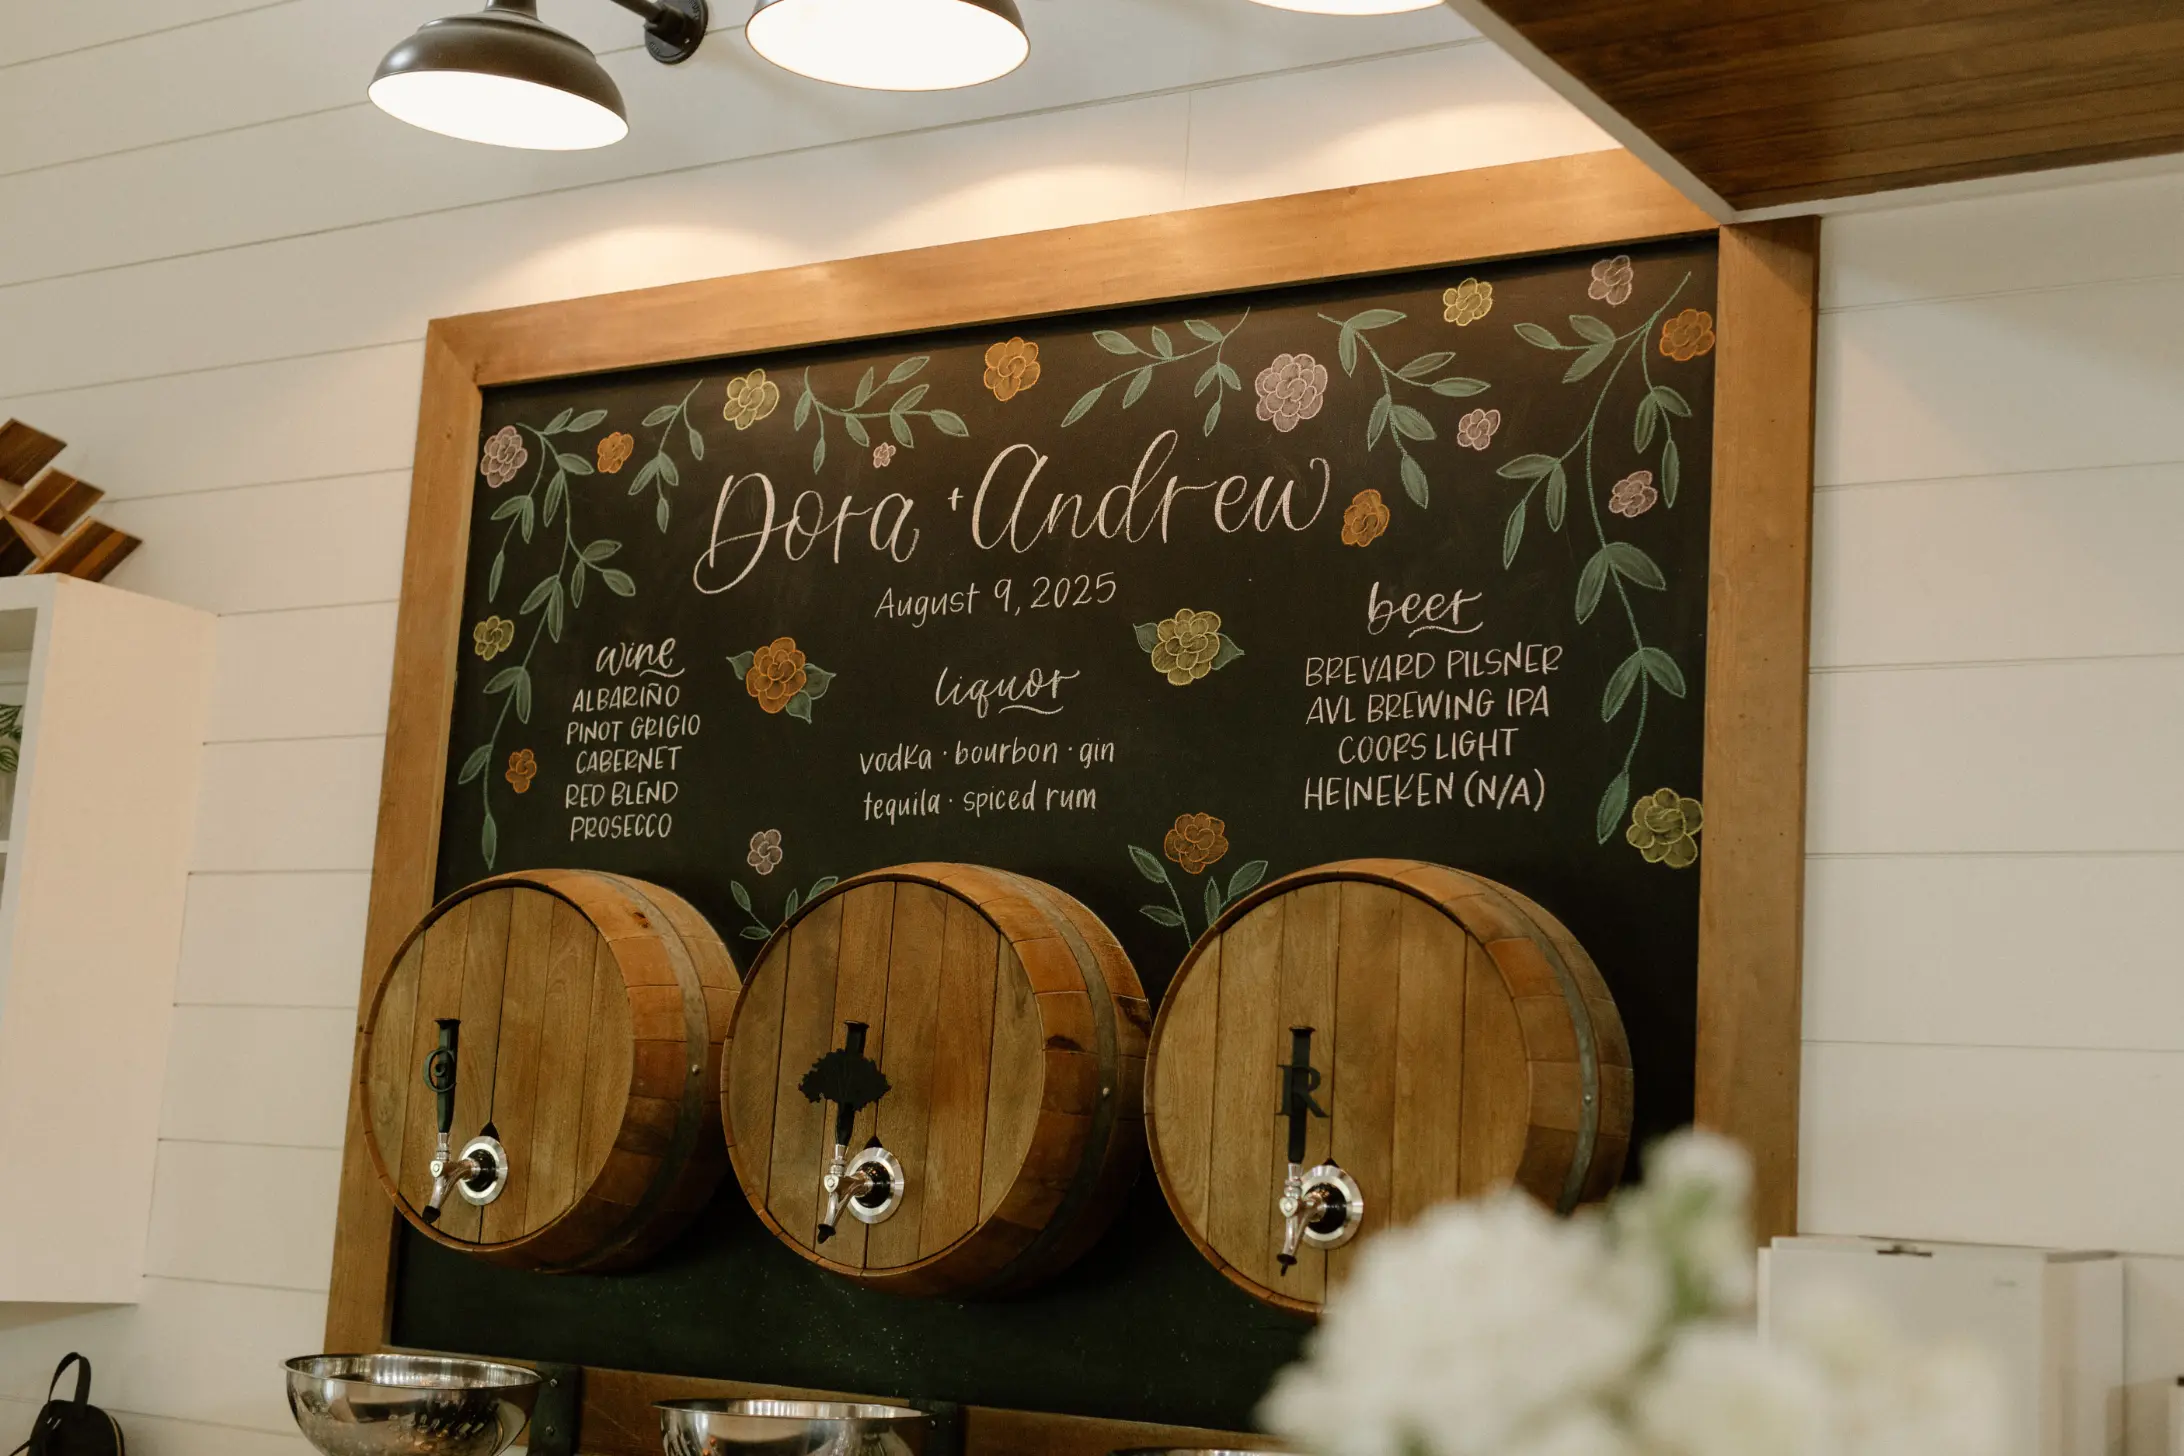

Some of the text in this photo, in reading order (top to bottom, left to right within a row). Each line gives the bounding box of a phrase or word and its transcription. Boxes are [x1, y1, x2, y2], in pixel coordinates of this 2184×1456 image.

[692, 471, 921, 595] Dora
[971, 429, 1331, 554] Andrew
[874, 571, 1117, 629] August 9, 2025
[1367, 581, 1484, 636] beer
[595, 637, 677, 677] wine
[1305, 641, 1563, 687] BREVARD PILSNER
[571, 682, 680, 713] ALBARIÑO
[935, 666, 1081, 719] liquor
[1305, 685, 1550, 725] AVL BREWING IPA
[566, 714, 701, 746] PINOT GRIGIO
[1338, 727, 1519, 765] COORS LIGHT
[576, 745, 683, 774] CABERNET
[955, 736, 1058, 765] bourbon
[1078, 737, 1116, 769] gin
[565, 780, 679, 809] RED BLEND
[863, 781, 1097, 825] tequila spiced rum
[1304, 768, 1545, 812] HEINEKEN (N/A)
[570, 813, 672, 842] PROSECCO
[1275, 1063, 1330, 1118] R
